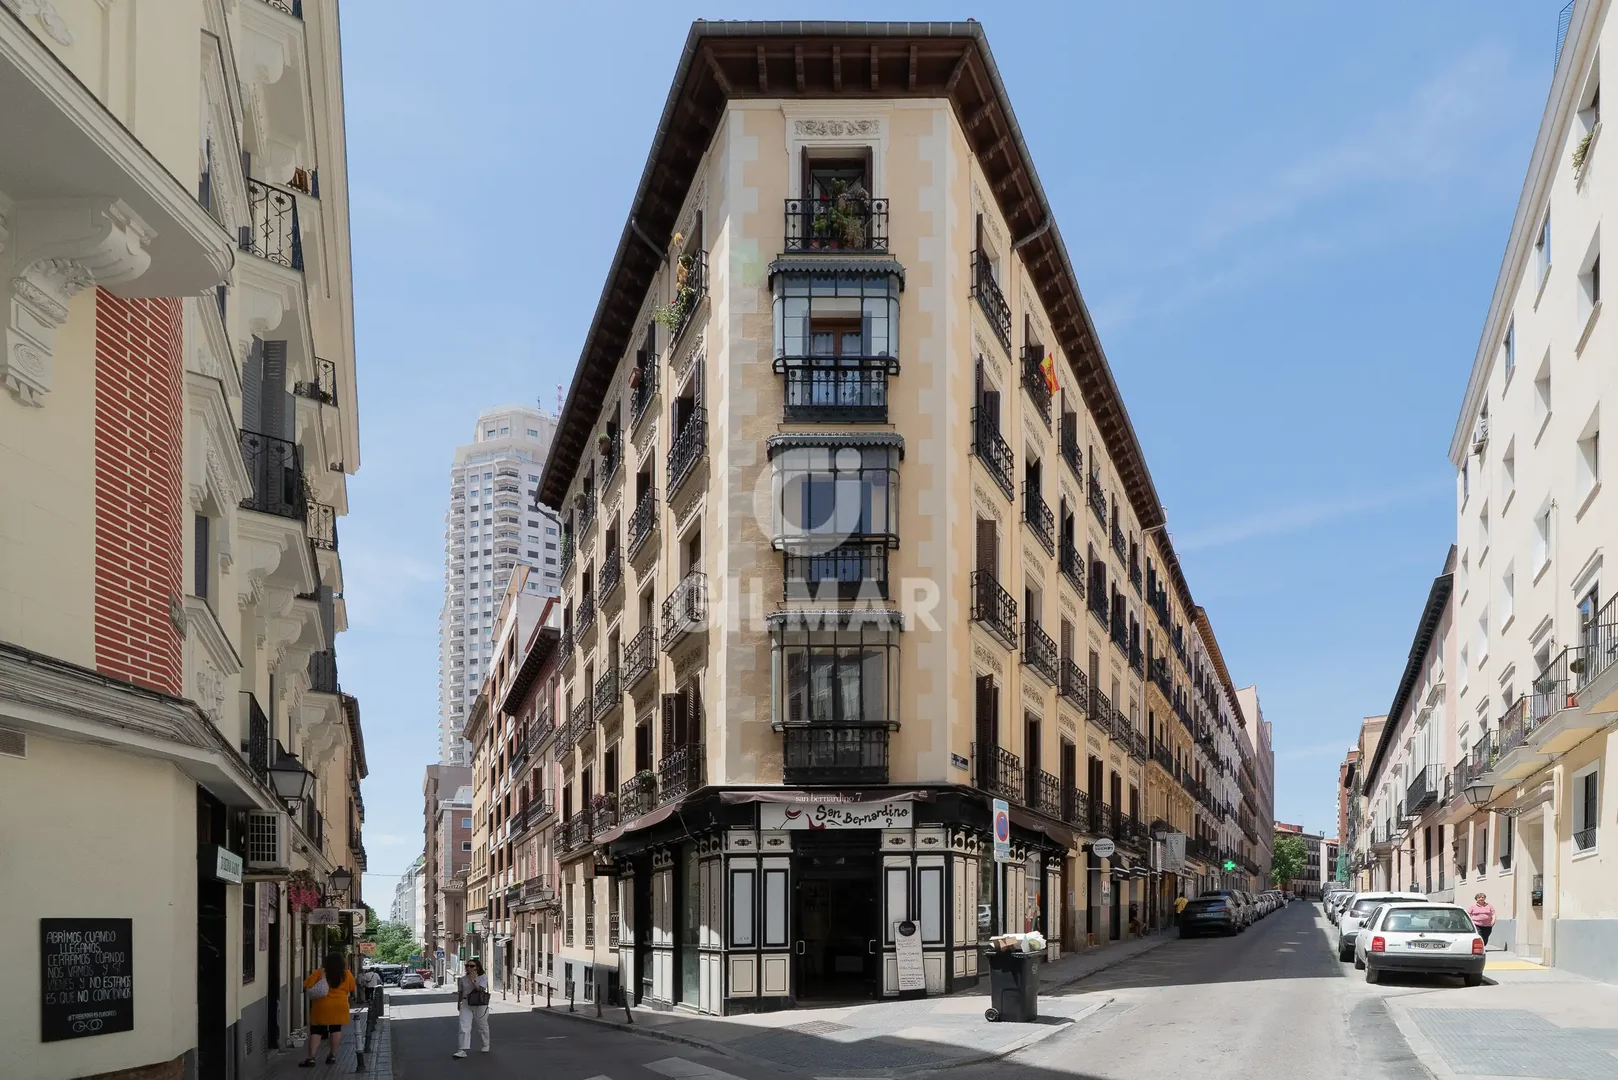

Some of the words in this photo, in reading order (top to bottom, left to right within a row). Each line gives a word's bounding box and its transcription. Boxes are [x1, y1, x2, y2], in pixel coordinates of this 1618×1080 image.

[795, 795, 810, 803] san
[811, 792, 855, 804] bernardino
[855, 792, 862, 802] 7
[816, 804, 842, 821] San
[843, 804, 910, 826] Bernardino
[886, 818, 894, 828] 7
[84, 930, 117, 943] CUANDO
[47, 953, 91, 967] CERRAMOS
[95, 951, 125, 964] CUANDO
[47, 966, 64, 979] NOS
[68, 965, 94, 977] VAMOS
[89, 976, 101, 988] NO
[102, 975, 132, 988] ESTAMOS
[45, 992, 57, 1005] ES
[60, 991, 76, 1004] QUE
[77, 989, 89, 1003] NO
